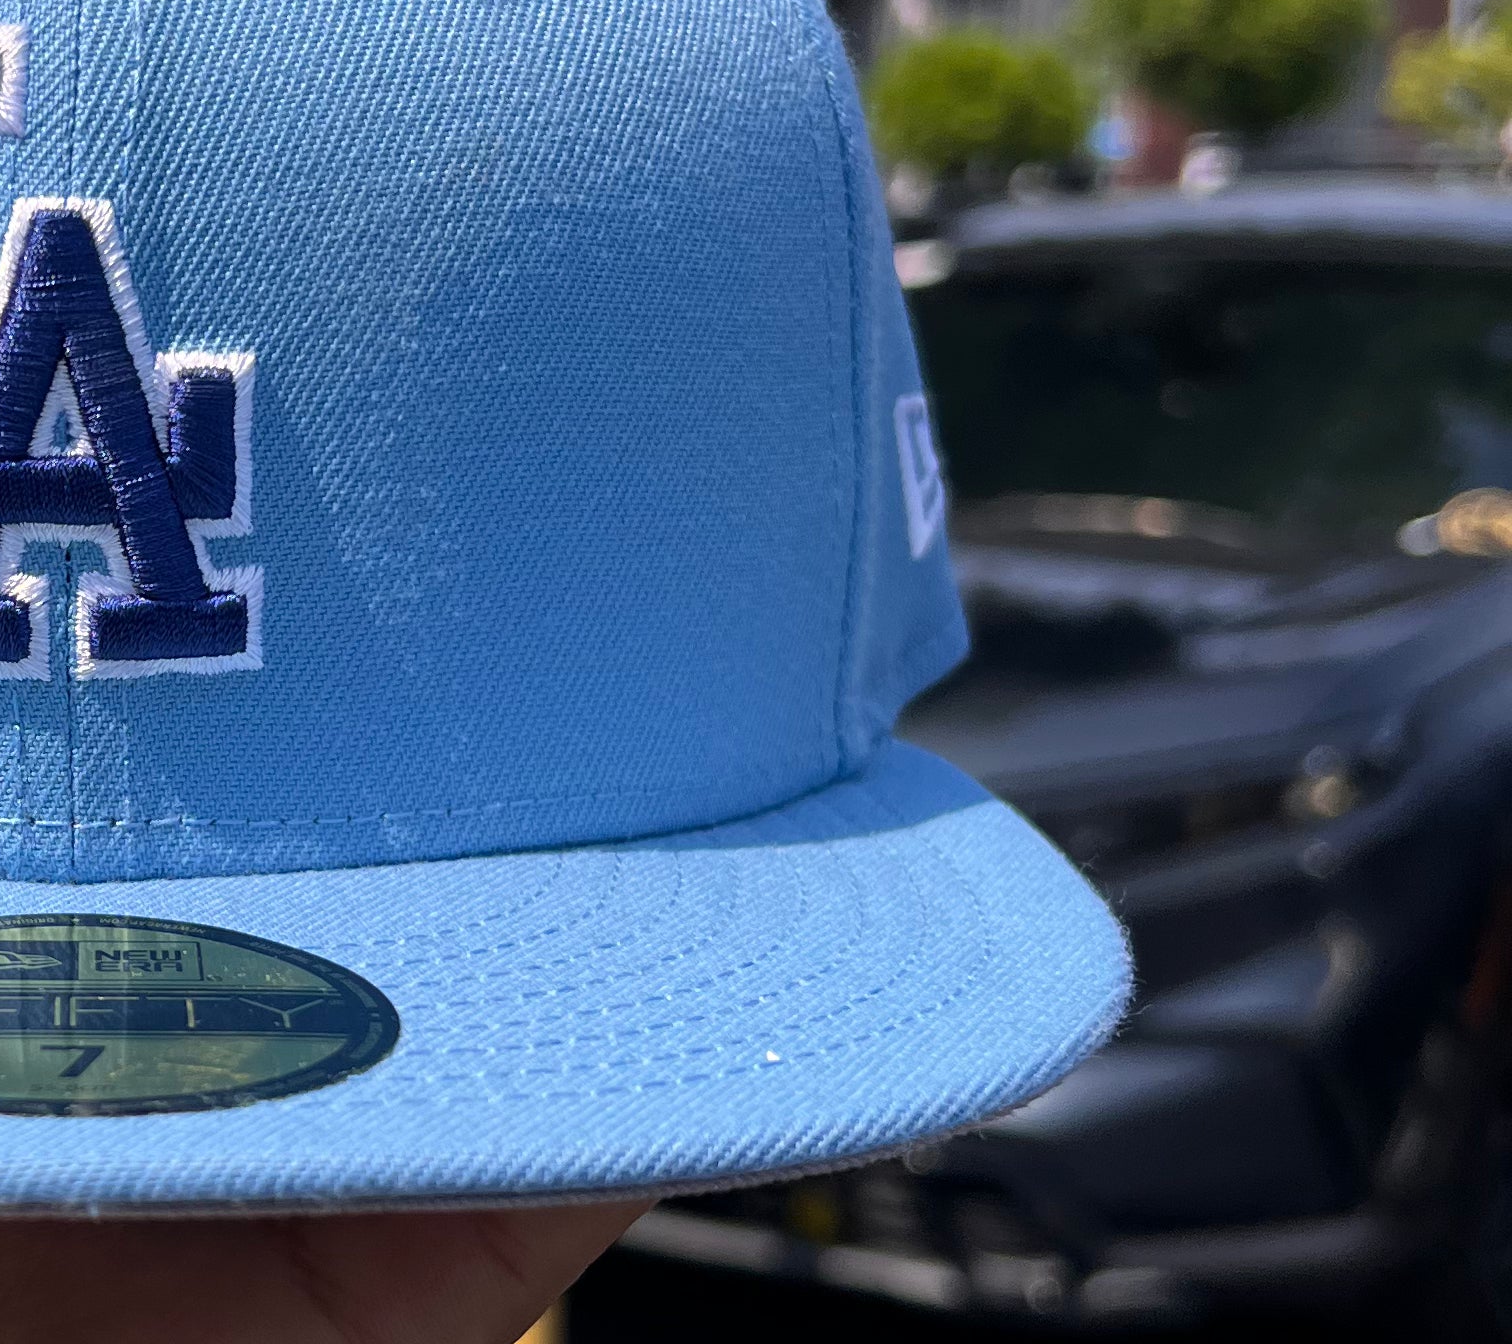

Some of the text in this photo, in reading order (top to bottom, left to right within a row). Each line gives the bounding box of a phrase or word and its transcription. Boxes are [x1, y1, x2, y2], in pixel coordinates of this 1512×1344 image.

[94, 949, 182, 961] NEW
[94, 961, 183, 973] ERA
[39, 1044, 106, 1078] 7
